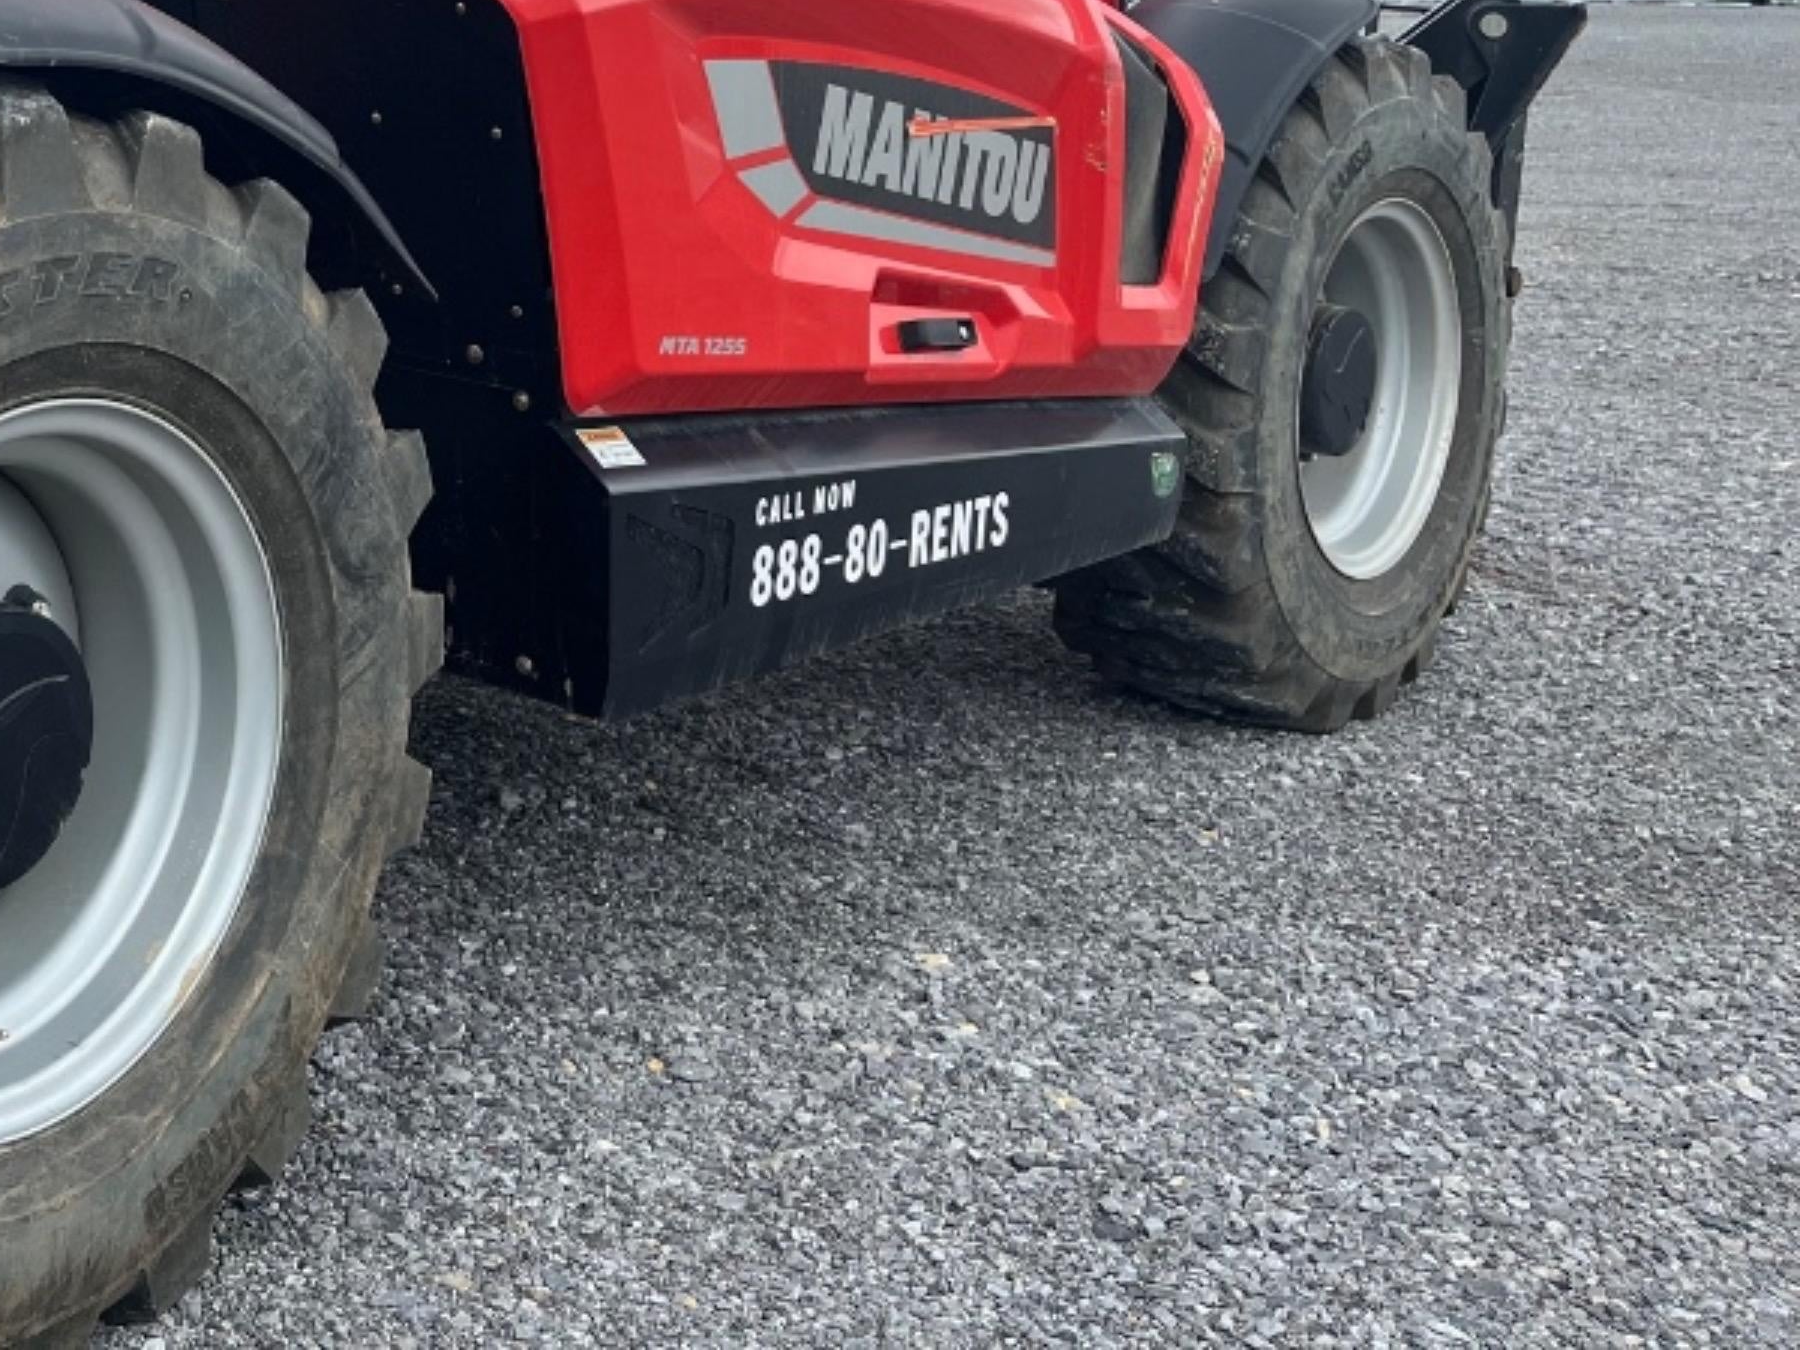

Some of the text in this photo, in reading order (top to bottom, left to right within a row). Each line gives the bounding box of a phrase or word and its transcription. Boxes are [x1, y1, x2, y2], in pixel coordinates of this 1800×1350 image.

[812, 83, 1051, 224] MANITOU
[750, 490, 1009, 607] 888-80-RENTS
[755, 479, 856, 527] CALL NOW
